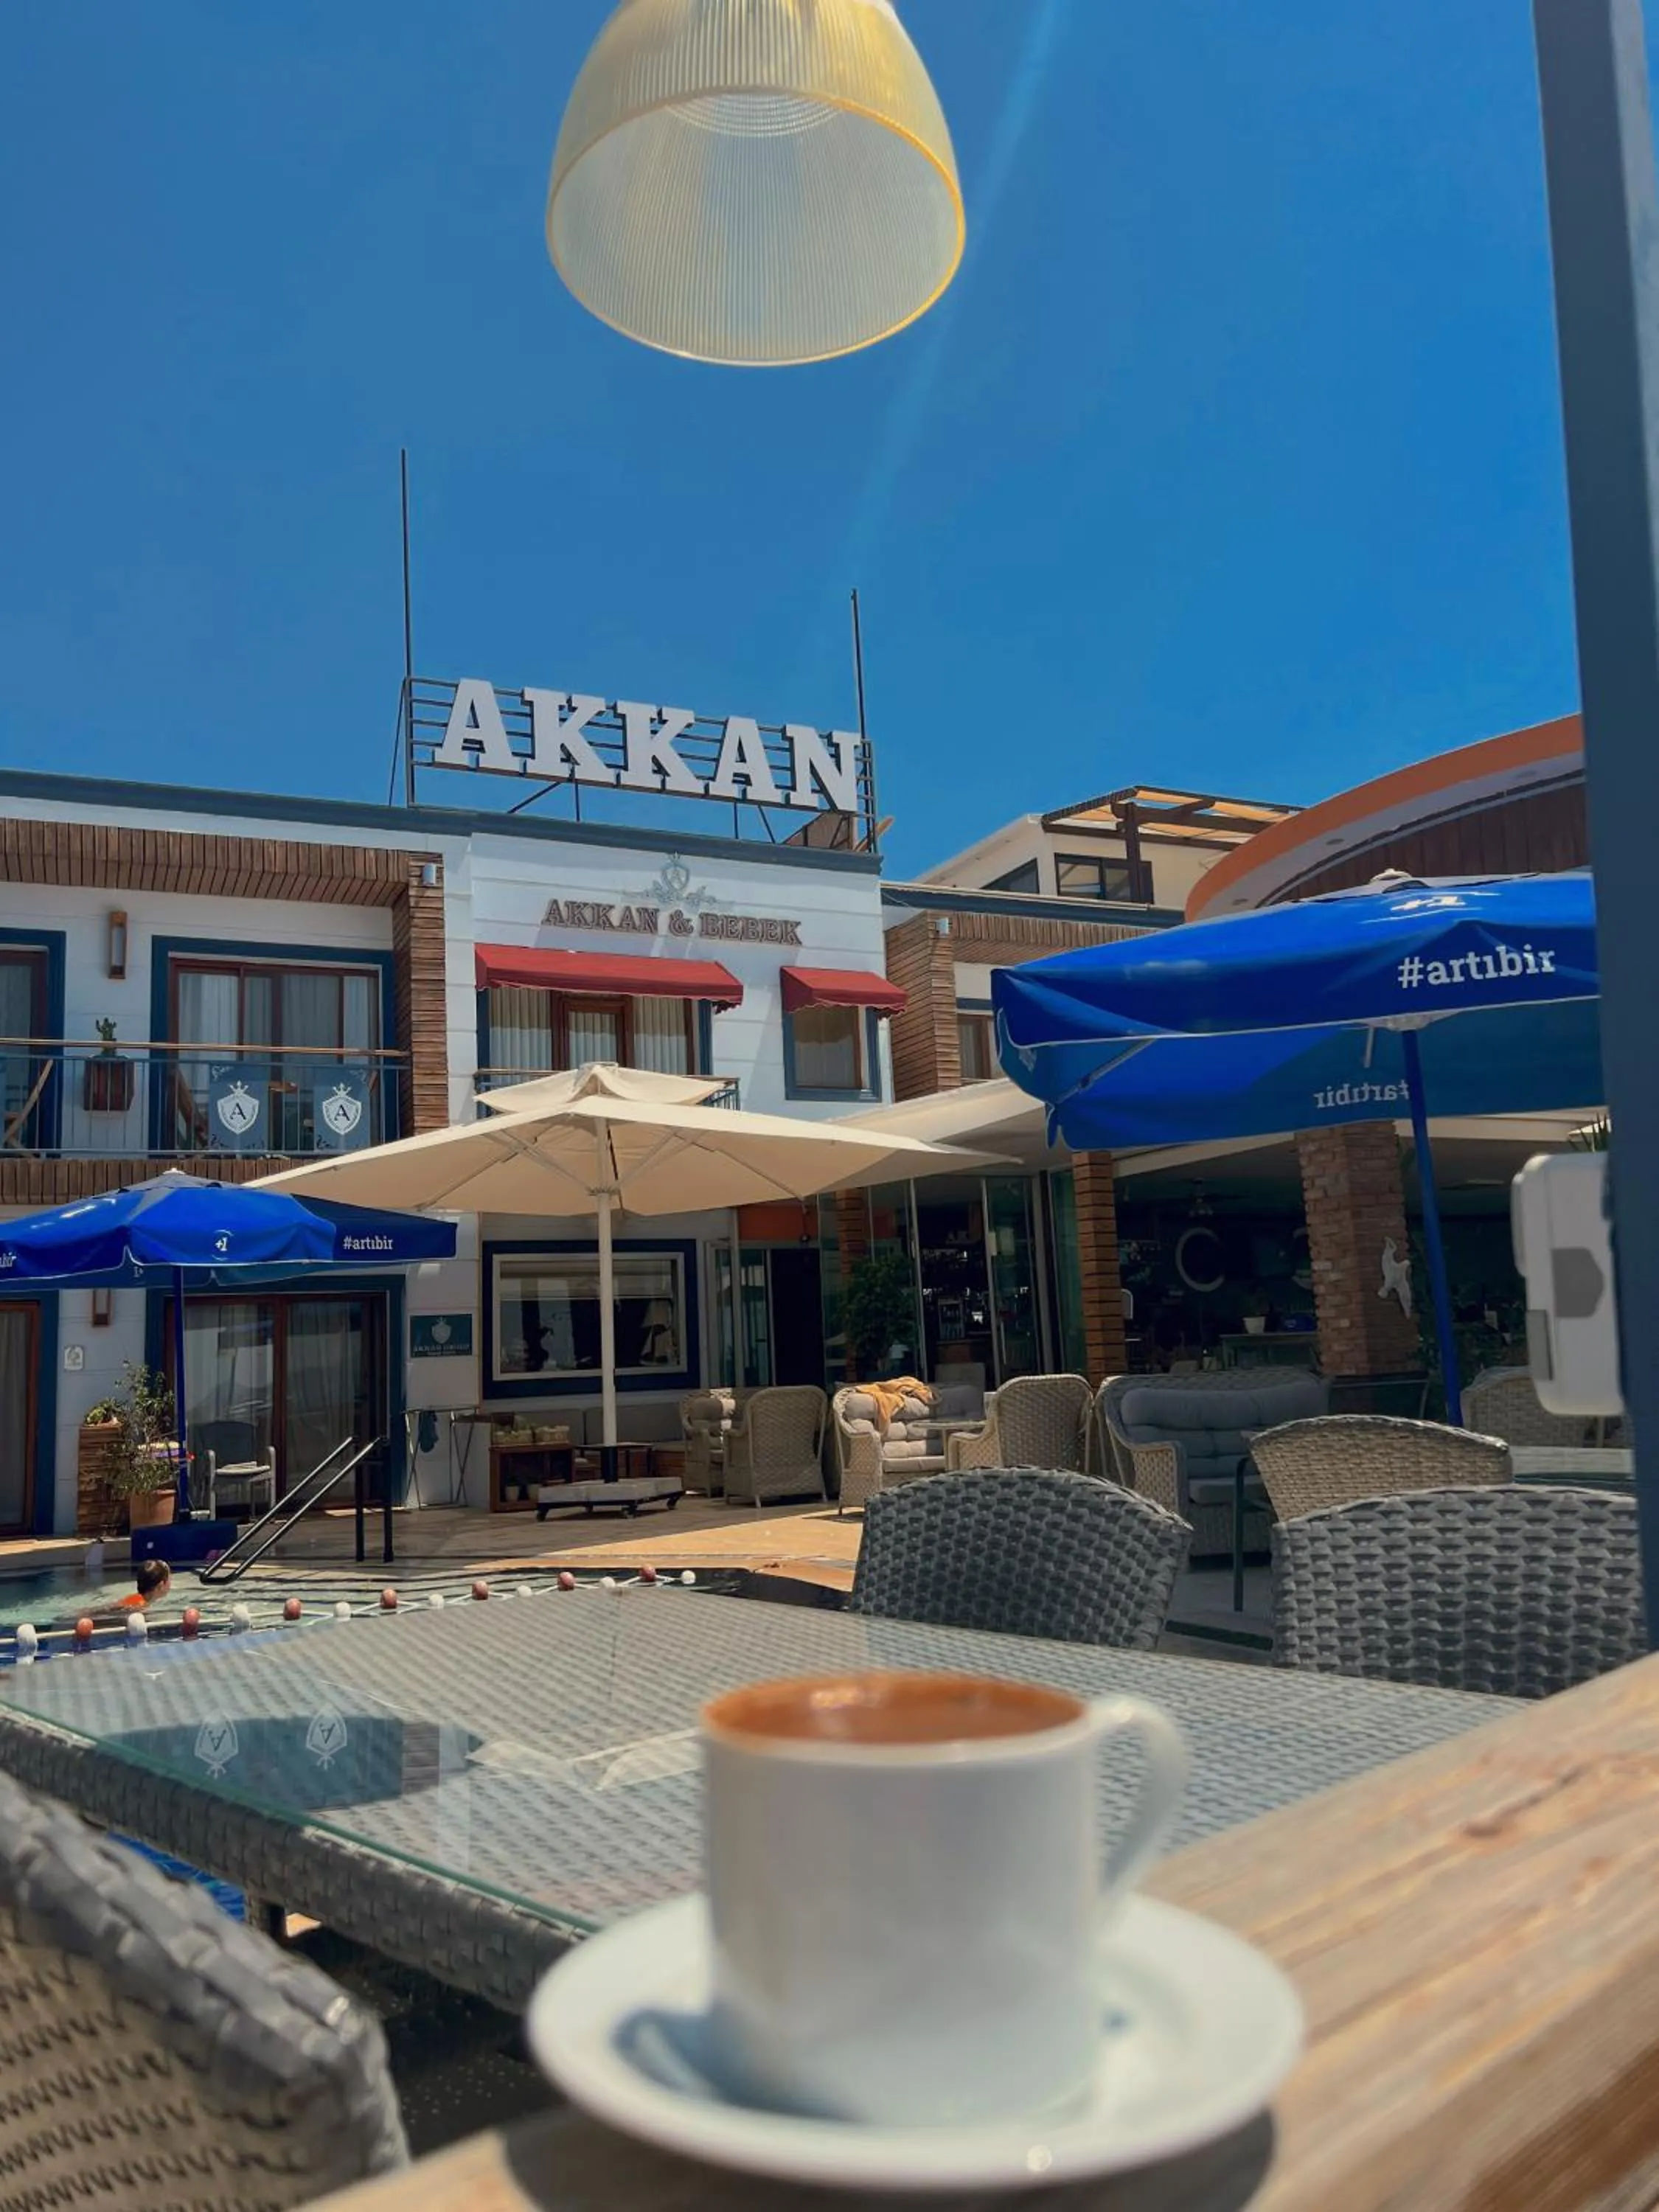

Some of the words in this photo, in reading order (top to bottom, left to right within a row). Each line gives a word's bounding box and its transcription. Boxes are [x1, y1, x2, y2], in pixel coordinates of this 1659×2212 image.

[433, 678, 861, 811] AKKAN
[540, 899, 659, 934] AKKAN
[669, 909, 693, 936] &
[699, 911, 803, 946] BEBEK
[1397, 944, 1556, 989] #artıbir
